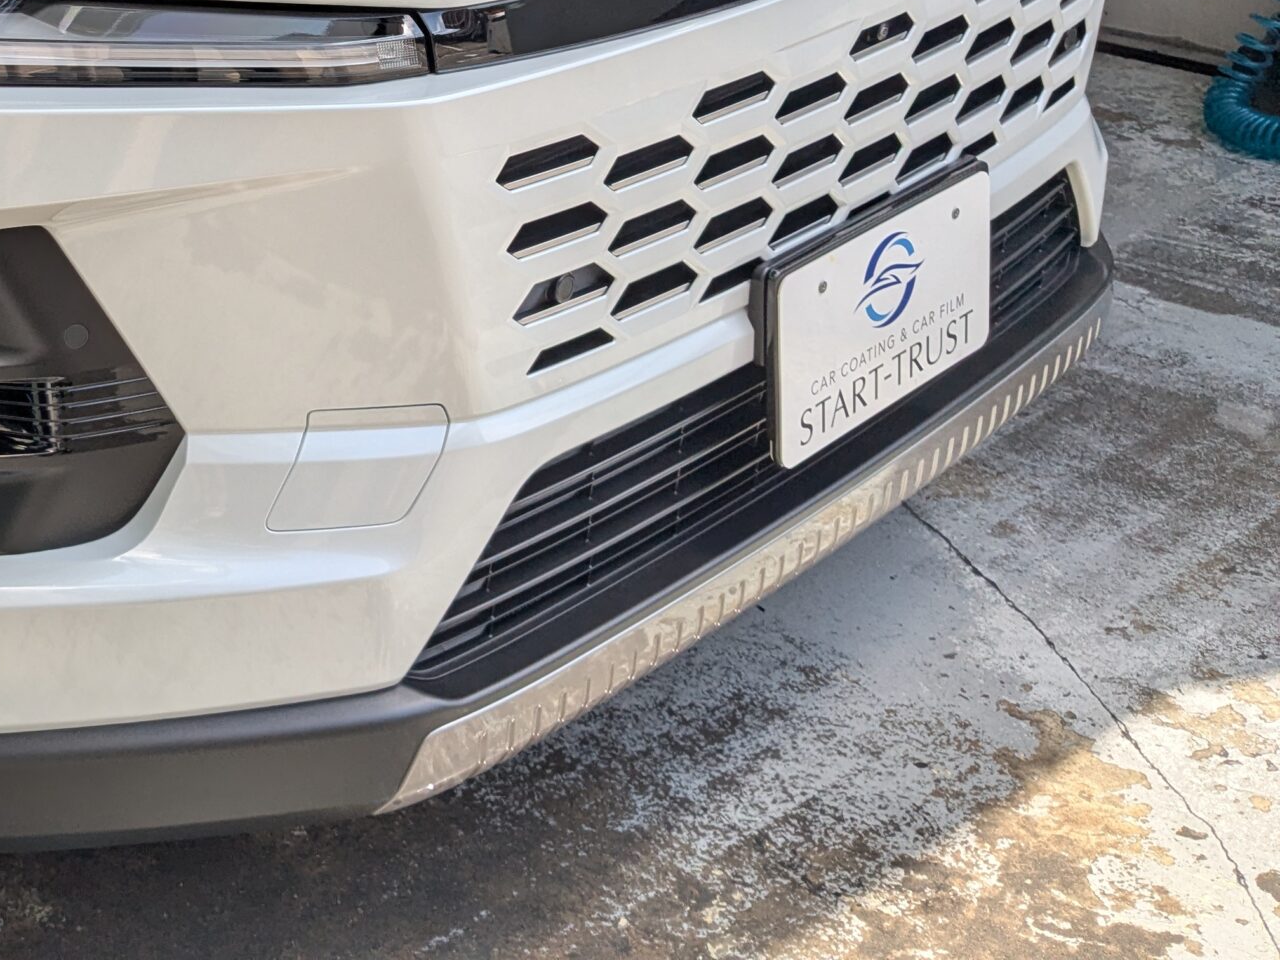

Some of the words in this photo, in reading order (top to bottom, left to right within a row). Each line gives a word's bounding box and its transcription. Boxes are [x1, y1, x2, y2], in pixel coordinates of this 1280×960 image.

[799, 309, 974, 446] START-TRUST
[811, 368, 836, 396] CAR
[840, 334, 895, 378] COATING
[899, 326, 908, 342] &
[912, 311, 935, 335] CAR
[939, 293, 965, 320] FILM
